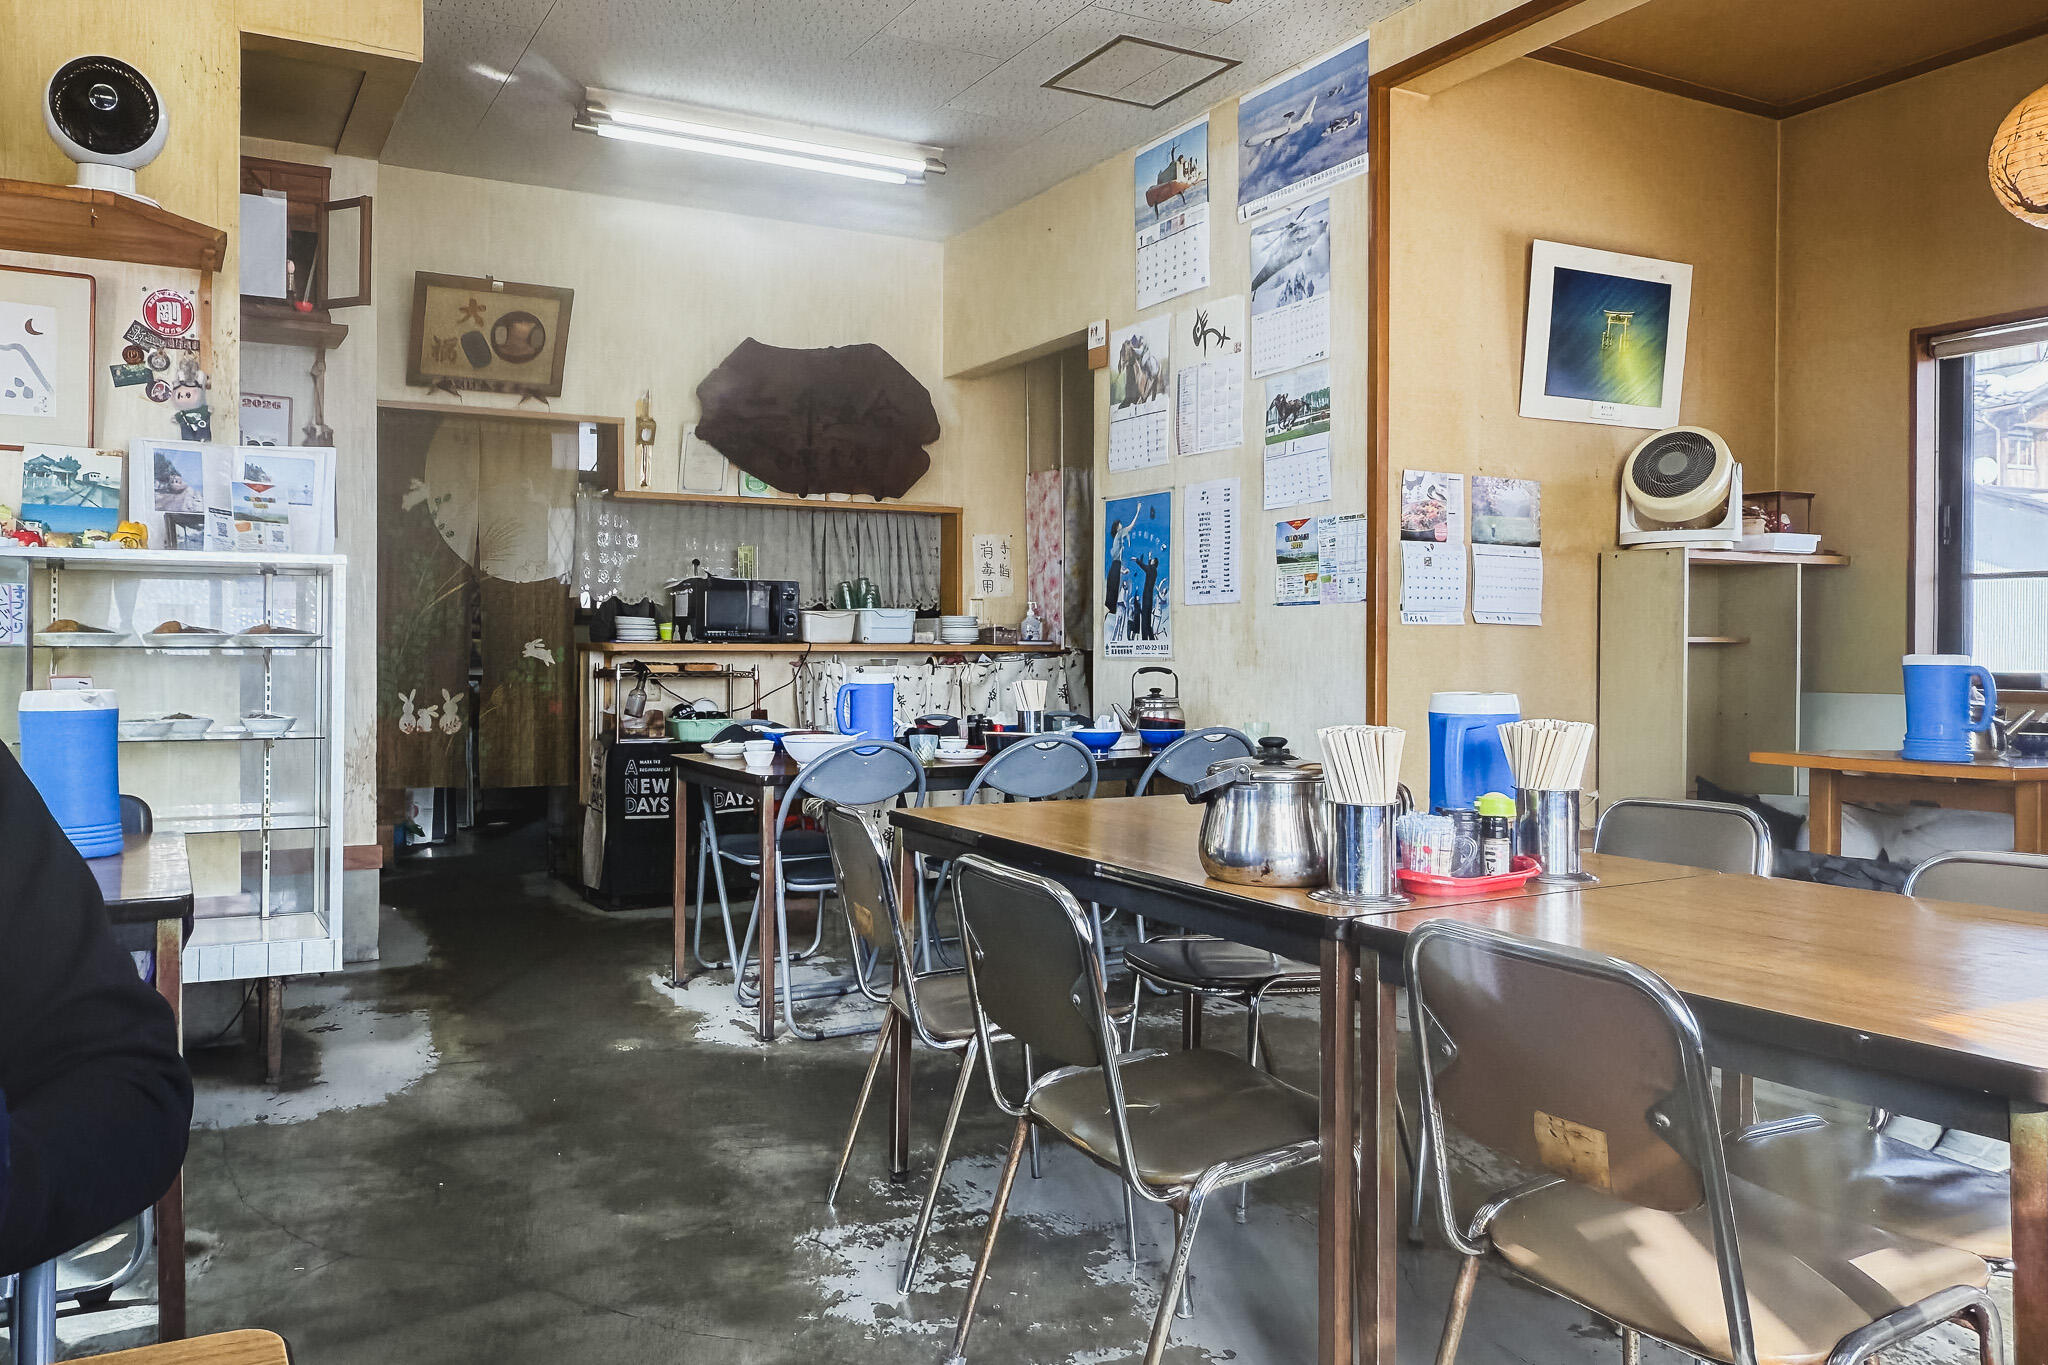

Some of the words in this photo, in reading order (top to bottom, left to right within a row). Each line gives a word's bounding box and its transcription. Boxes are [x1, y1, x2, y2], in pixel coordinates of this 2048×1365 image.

[624, 759, 639, 775] A
[624, 777, 670, 795] NEW
[624, 796, 670, 814] DAYS
